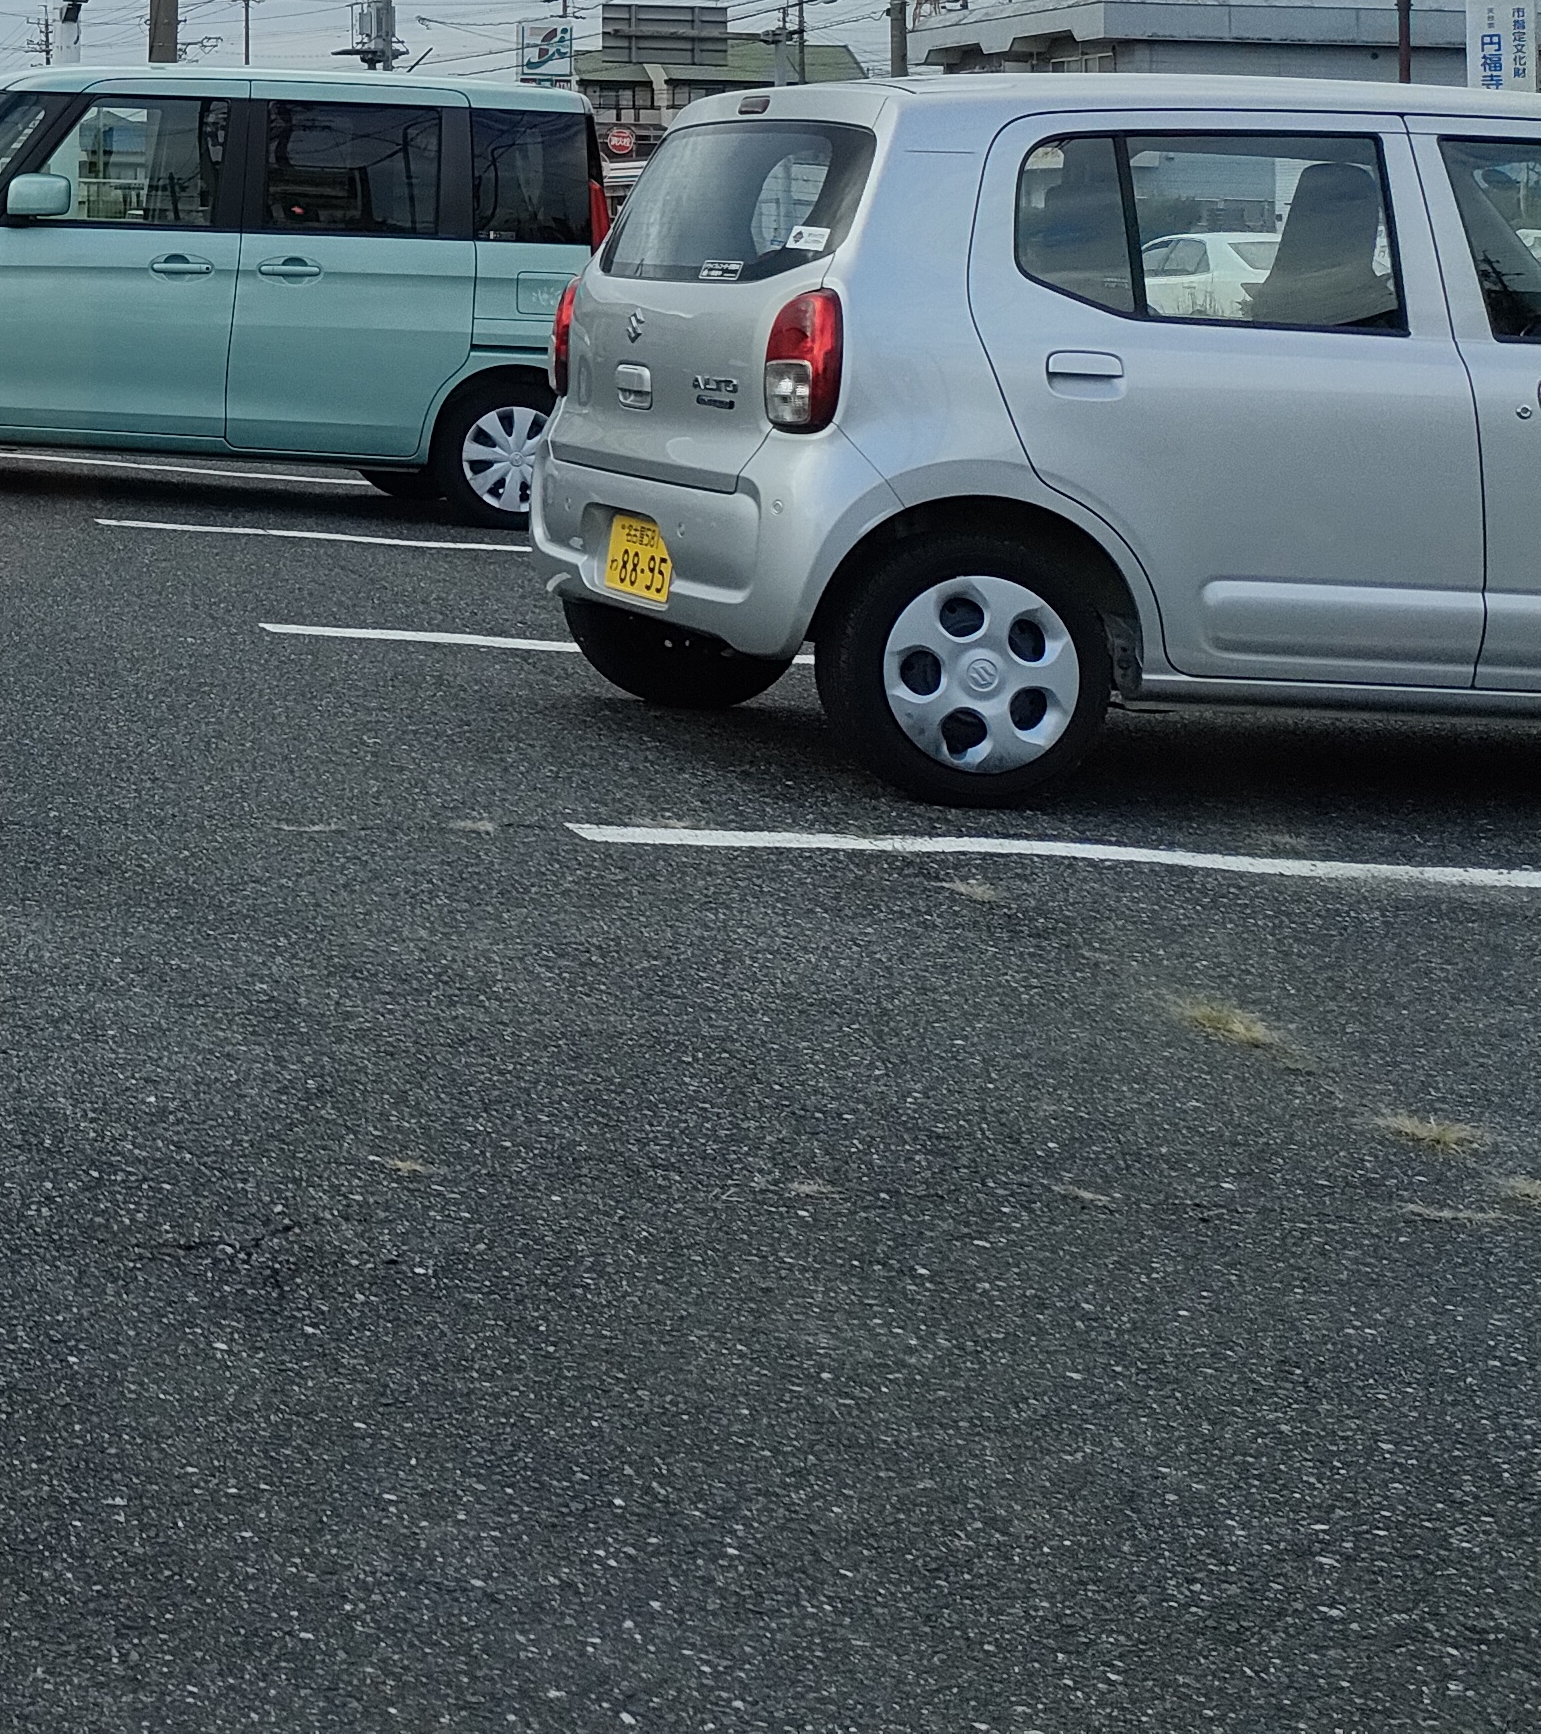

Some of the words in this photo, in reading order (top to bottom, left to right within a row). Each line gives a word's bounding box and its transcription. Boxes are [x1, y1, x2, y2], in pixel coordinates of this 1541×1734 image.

[1481, 34, 1503, 89] 円福寺
[1512, 8, 1526, 78] 市指定文化財
[619, 548, 668, 593] 88-95
